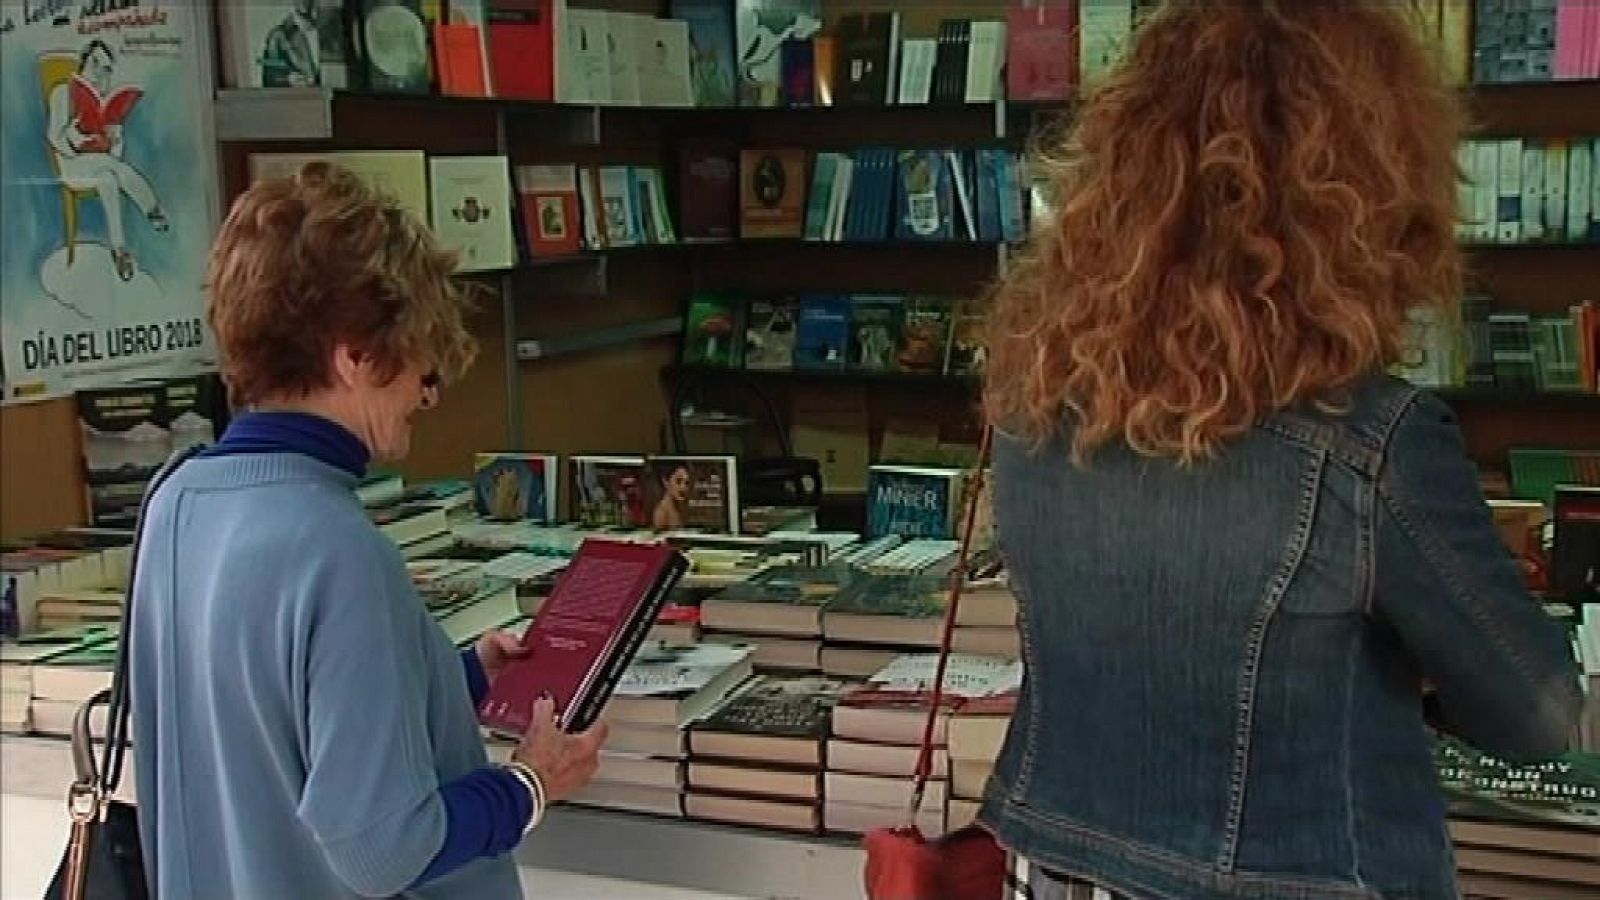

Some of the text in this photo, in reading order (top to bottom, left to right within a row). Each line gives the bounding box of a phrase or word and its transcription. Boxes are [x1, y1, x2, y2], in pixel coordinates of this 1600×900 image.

[23, 330, 59, 370] DÍA
[63, 331, 103, 363] DEL
[106, 324, 161, 358] LIBRO
[166, 318, 203, 350] 2018
